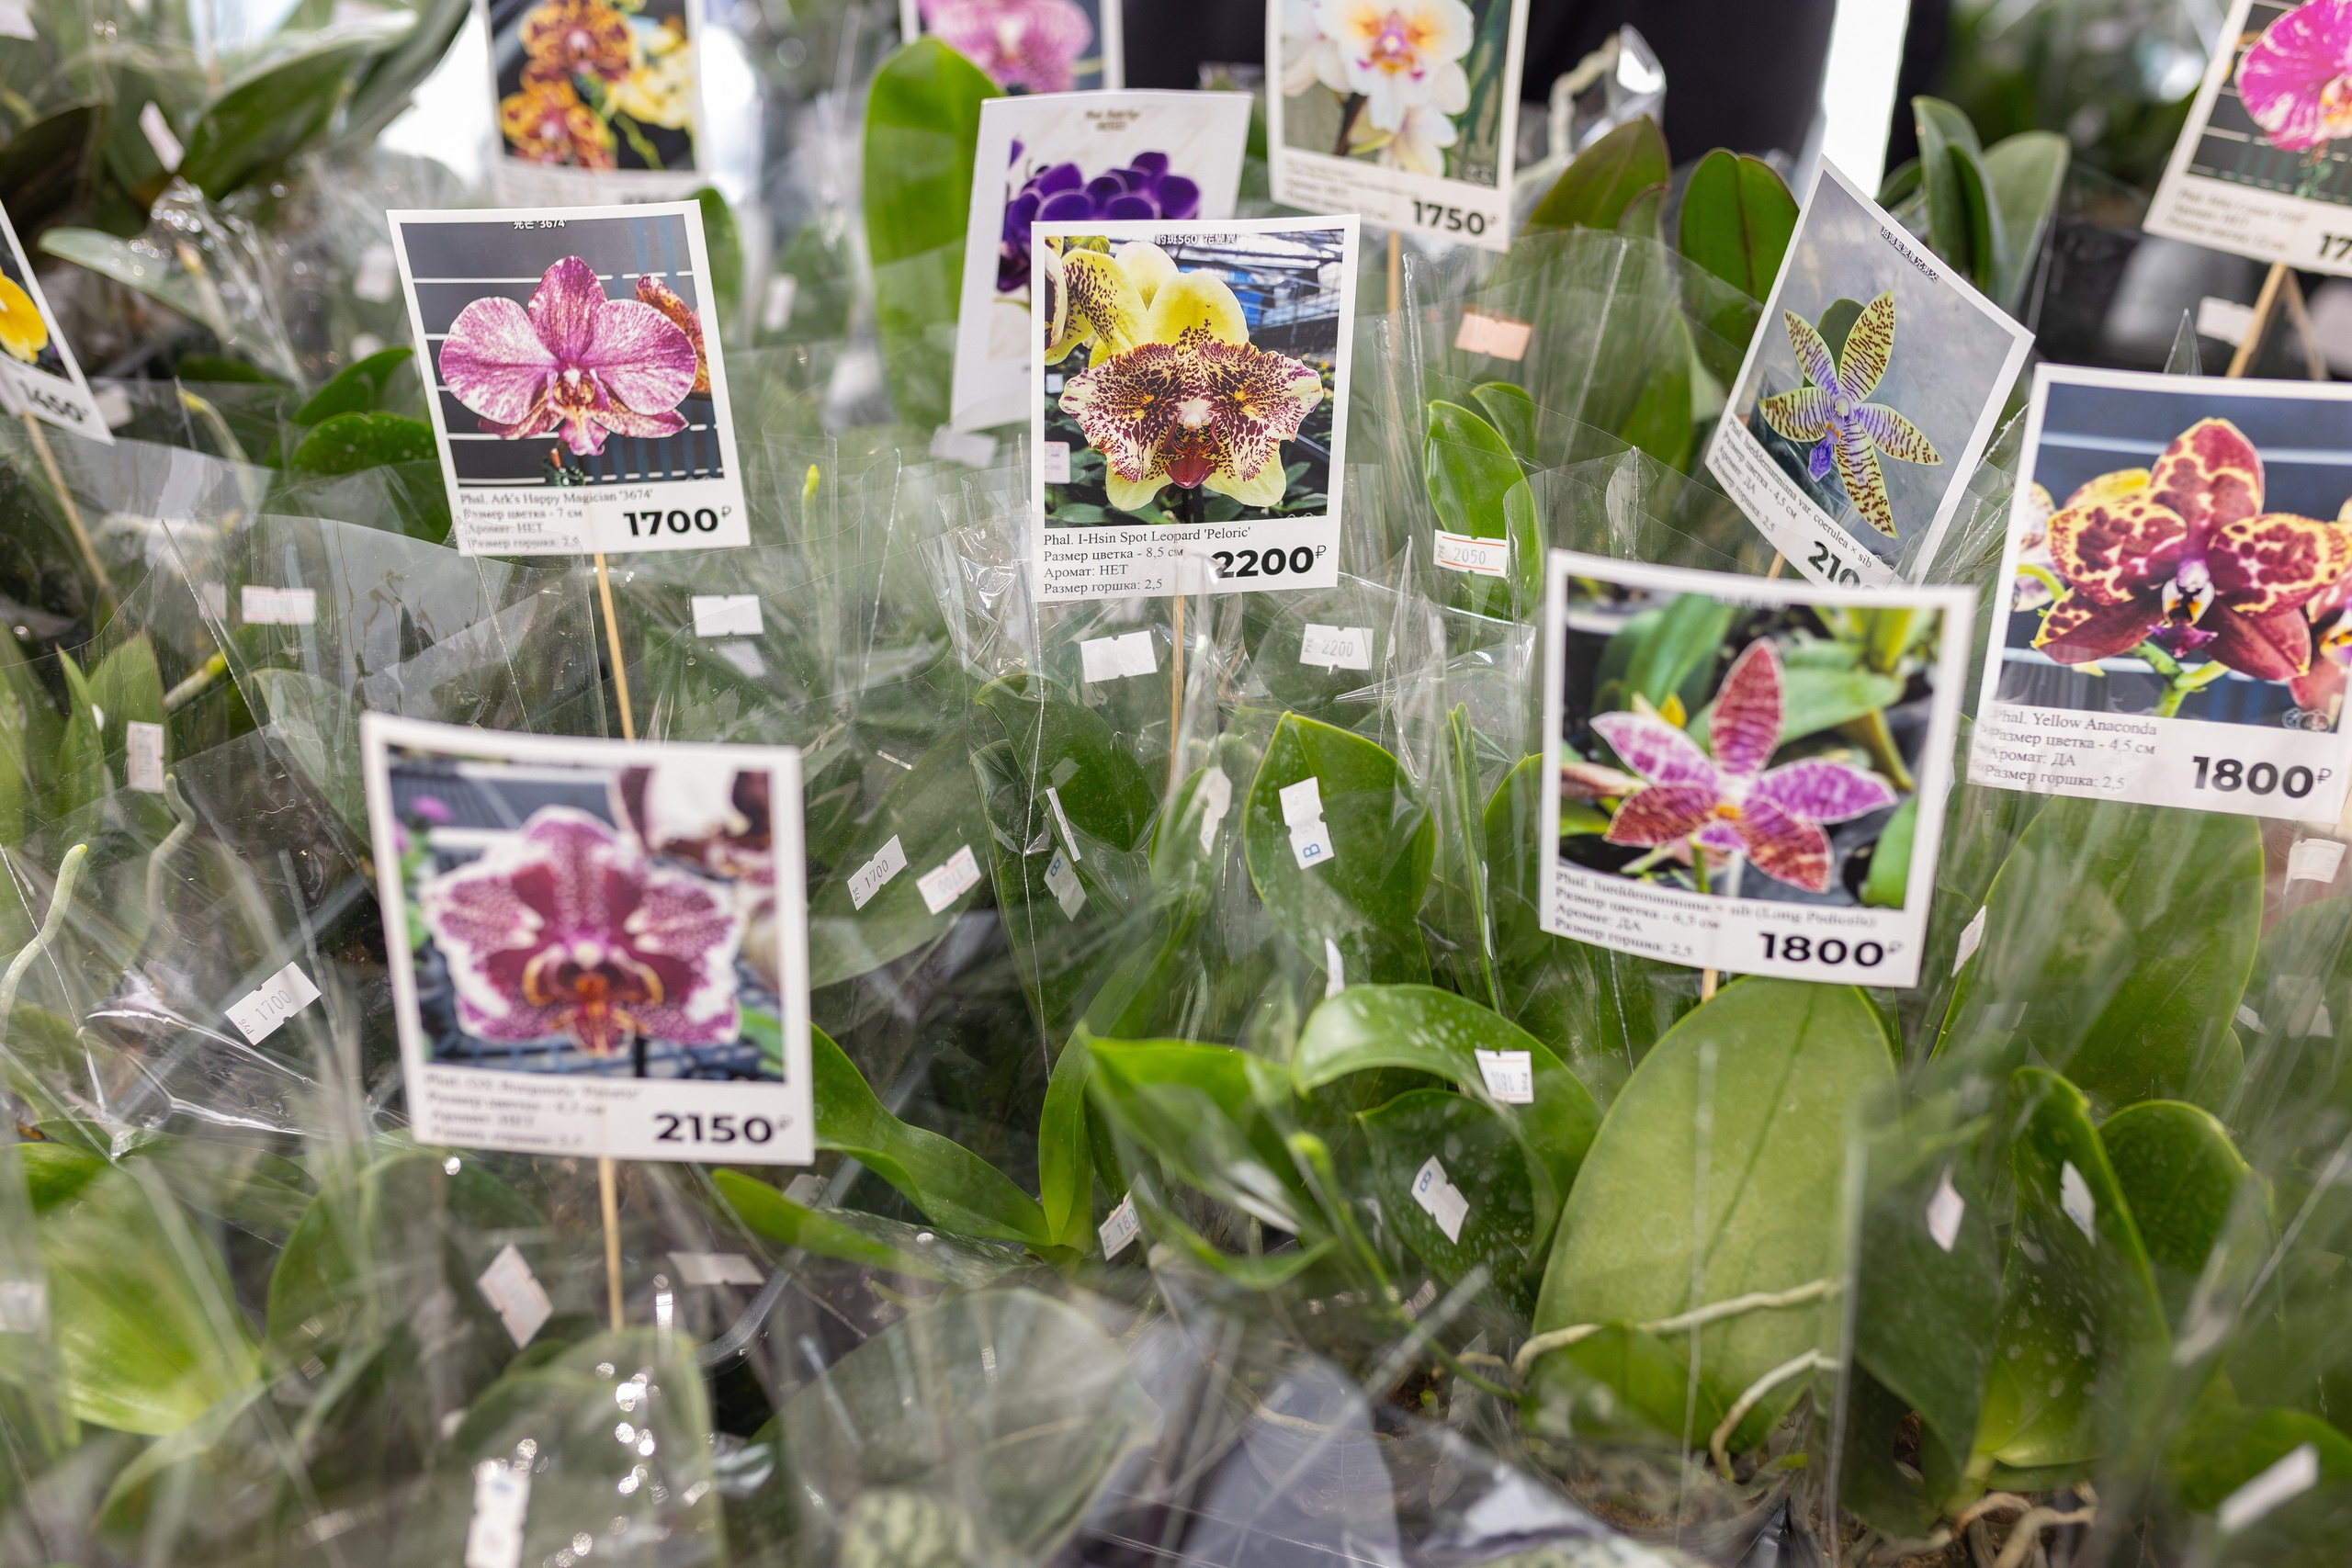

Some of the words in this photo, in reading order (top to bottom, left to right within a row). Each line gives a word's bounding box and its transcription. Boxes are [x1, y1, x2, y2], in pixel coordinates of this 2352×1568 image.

[2319, 233, 2352, 261] 17
[460, 494, 488, 505] Phal.
[523, 491, 560, 508] Happy
[563, 491, 616, 506] Magician
[1044, 534, 1073, 546] Phal.
[1078, 532, 1116, 545] I-Hsin
[1120, 530, 1148, 546] Spot
[1151, 528, 1201, 545] Leopard
[1204, 526, 1251, 540] 'Peloric'
[1814, 513, 1849, 549] coerulea
[1858, 552, 1872, 569] sib
[1044, 551, 1088, 565] Размер
[1091, 549, 1134, 562] цветка
[1146, 547, 1164, 559] 8,5
[1168, 548, 1183, 558] см
[1453, 547, 1487, 565] 2050
[1807, 540, 1878, 591] 210
[1044, 567, 1095, 580] Аромат:
[1099, 564, 1128, 577] НЕТ
[1044, 582, 1088, 596] Размер
[1091, 580, 1141, 593] горшка:
[1144, 579, 1162, 591] 2,5
[1322, 639, 1353, 658] 2200
[2033, 712, 2080, 730] Yellow
[2084, 717, 2157, 736] Anaconda
[2045, 735, 2095, 750] цветка
[2134, 743, 2155, 755] см
[2051, 753, 2076, 768] ДА
[1984, 764, 2036, 784] Размер
[2040, 772, 2098, 790] горшка:
[2102, 776, 2125, 791] 2,5
[865, 859, 889, 888] 1700
[254, 989, 291, 1021] 1700
[1117, 1208, 1137, 1236] 180
